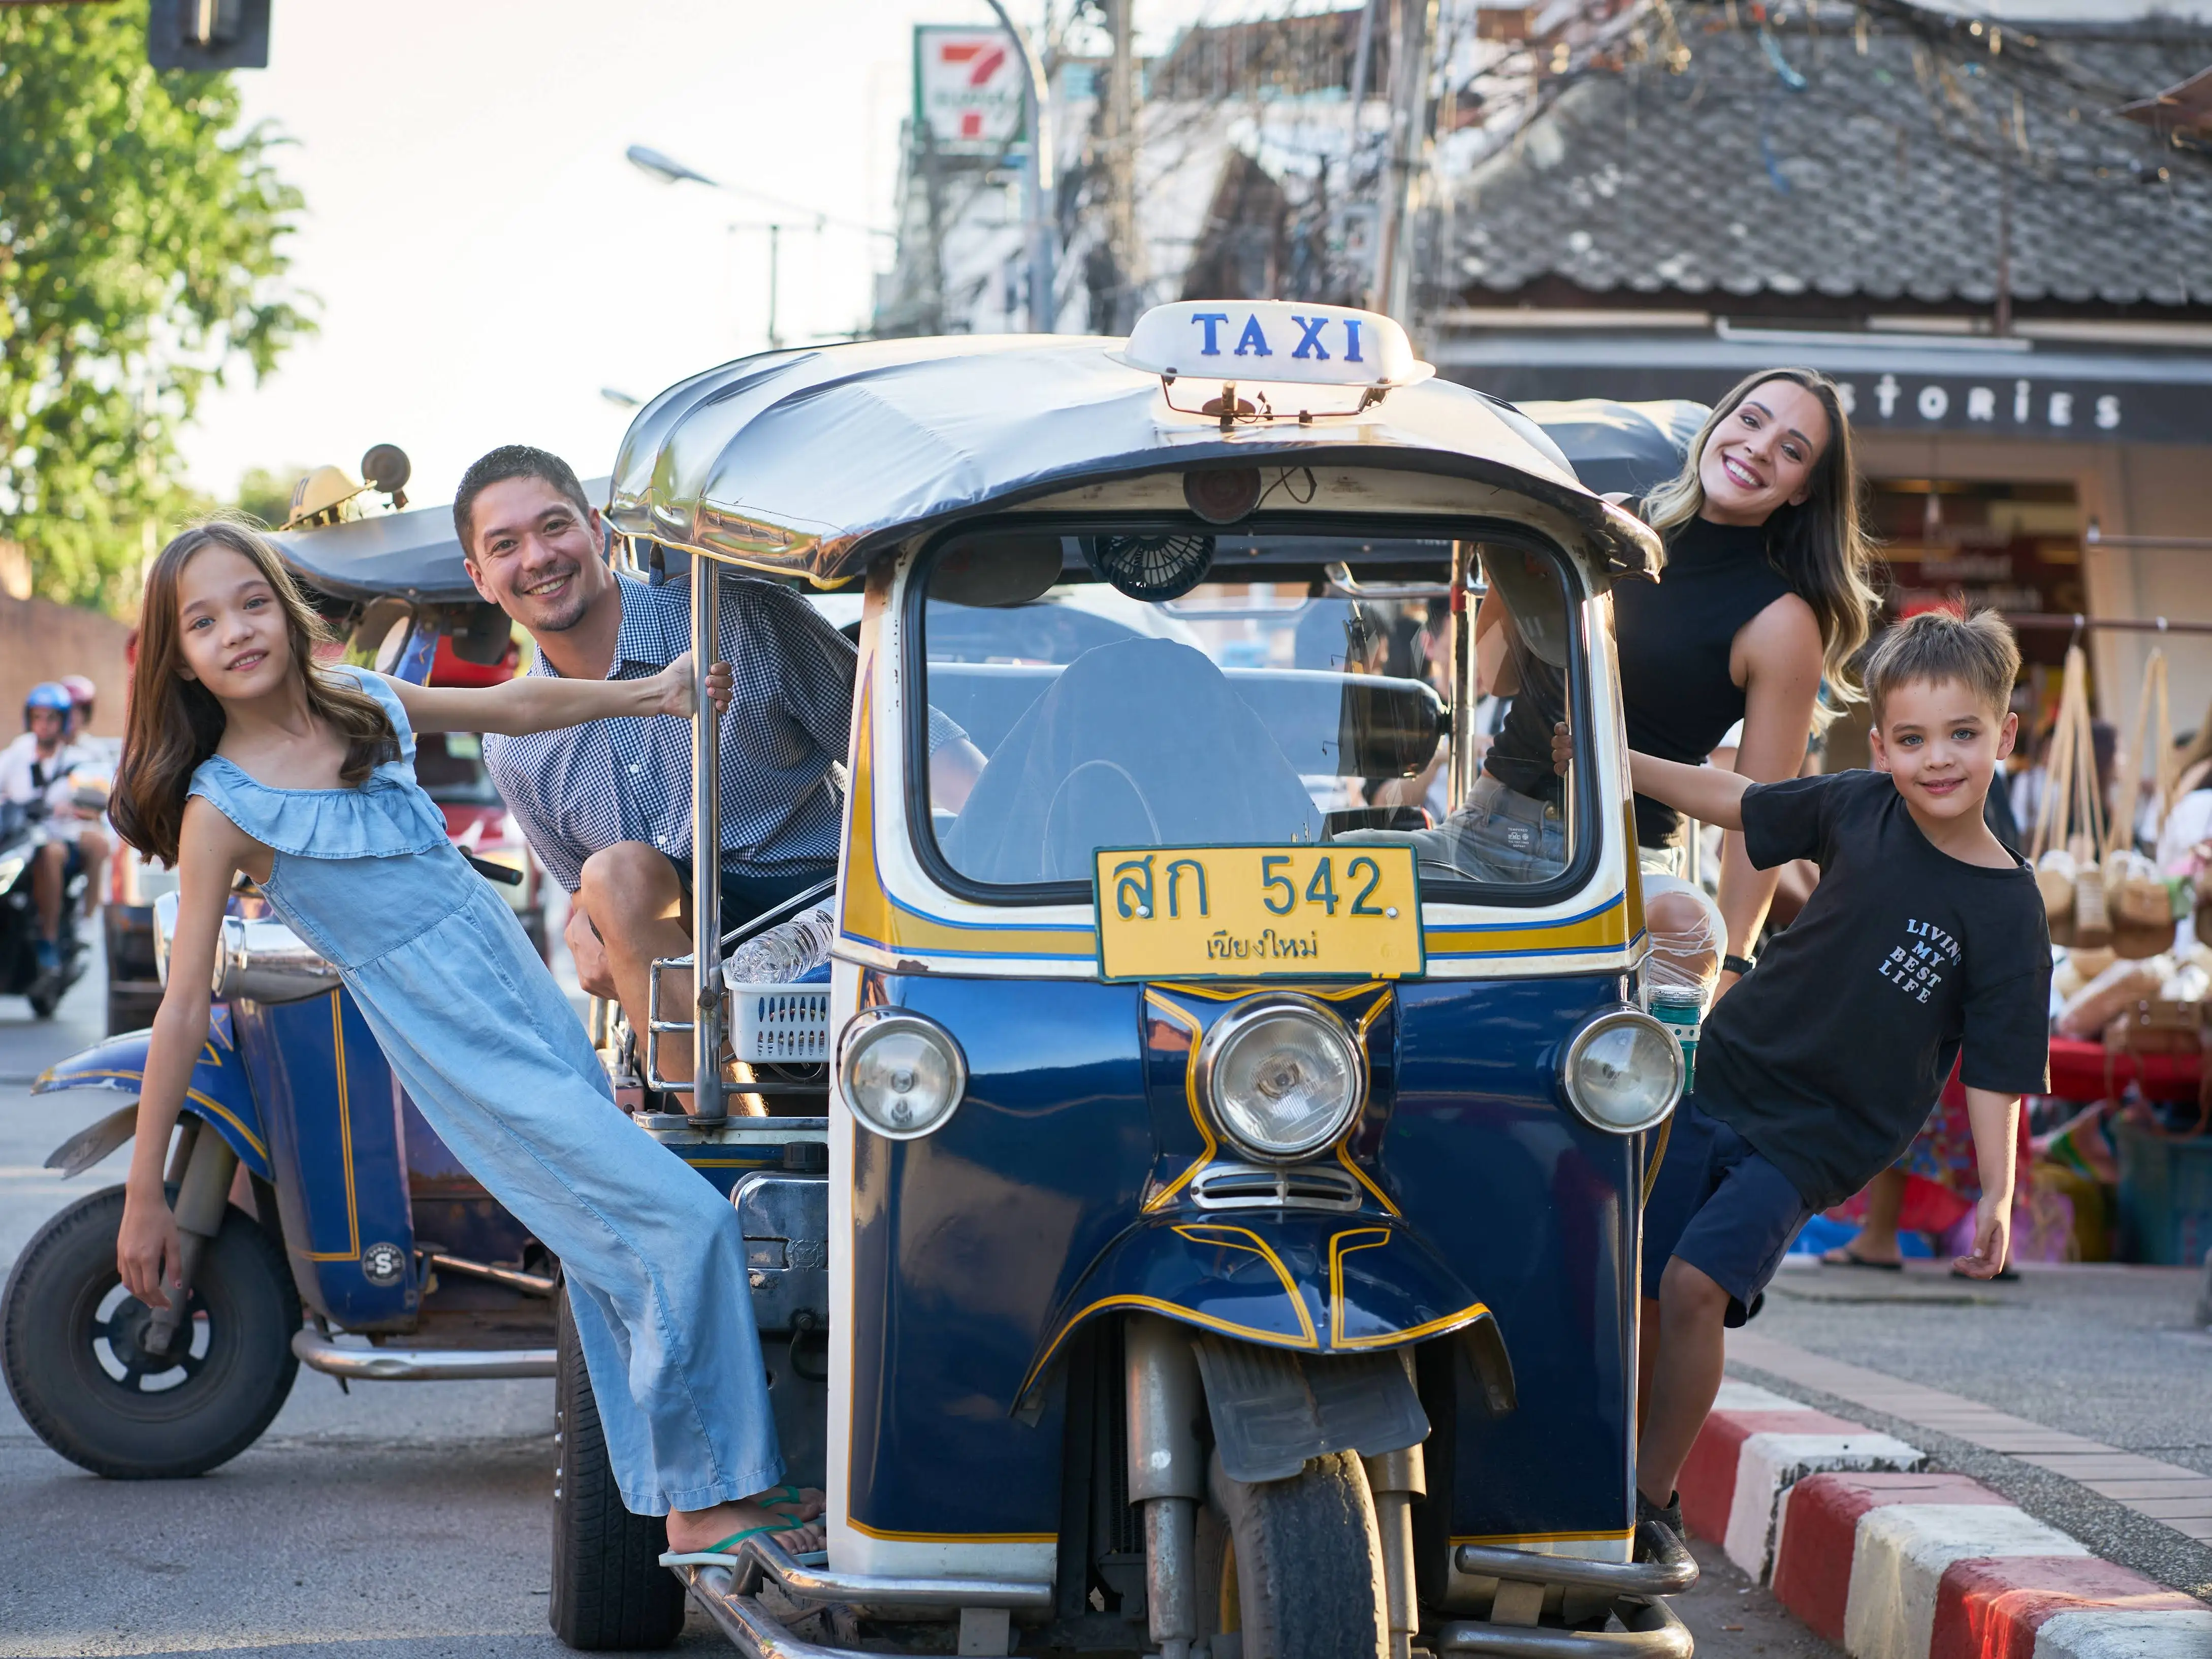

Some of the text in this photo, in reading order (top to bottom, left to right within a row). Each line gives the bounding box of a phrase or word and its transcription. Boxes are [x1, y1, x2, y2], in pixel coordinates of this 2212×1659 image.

[1192, 313, 1363, 362] TAXI
[1113, 855, 1383, 919] สก 542
[1207, 929, 1318, 960] เชียงใหม่
[1911, 940, 1945, 968] MY
[1878, 960, 1931, 1004] LIFE
[1889, 946, 1942, 988] BEST
[375, 1253, 392, 1274] S
